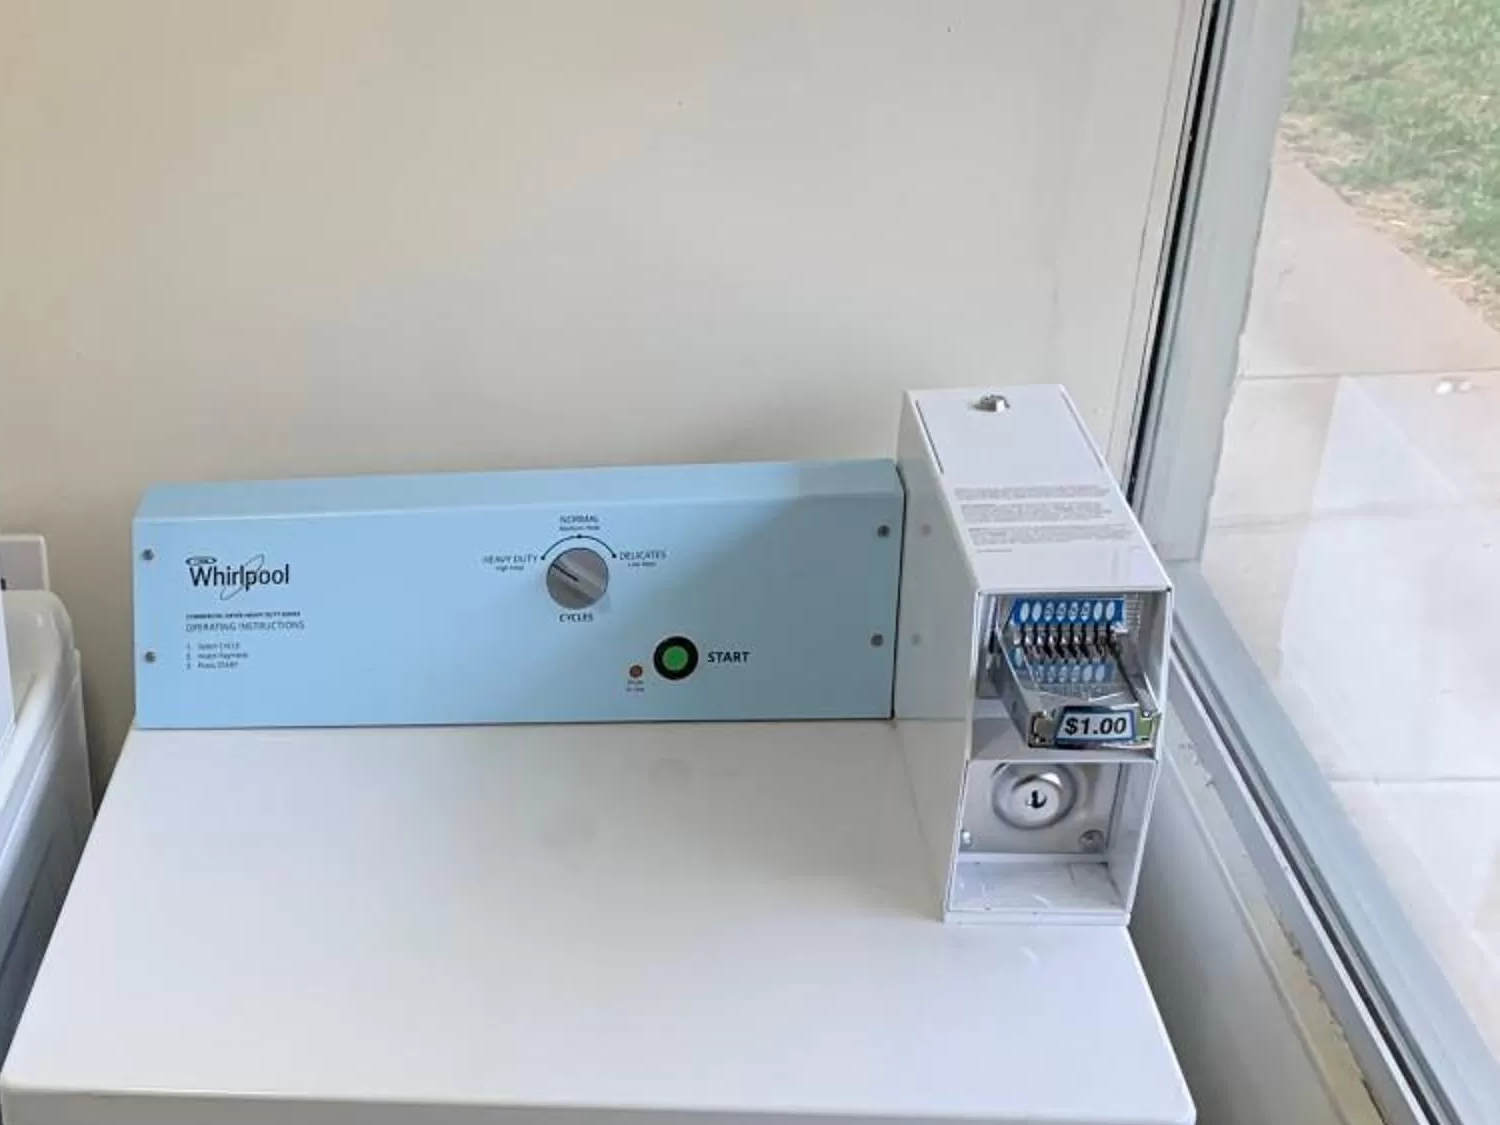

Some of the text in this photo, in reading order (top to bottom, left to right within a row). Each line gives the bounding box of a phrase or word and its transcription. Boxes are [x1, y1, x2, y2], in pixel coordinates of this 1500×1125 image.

[513, 553, 539, 563] DUTY
[619, 550, 667, 560] DELICATES
[188, 563, 290, 592] Whirlpool
[559, 613, 594, 623] CYCLES
[185, 619, 305, 632] OPERATING INSTRUCTIONS
[707, 651, 751, 663] START
[1063, 717, 1128, 736] $1.00
